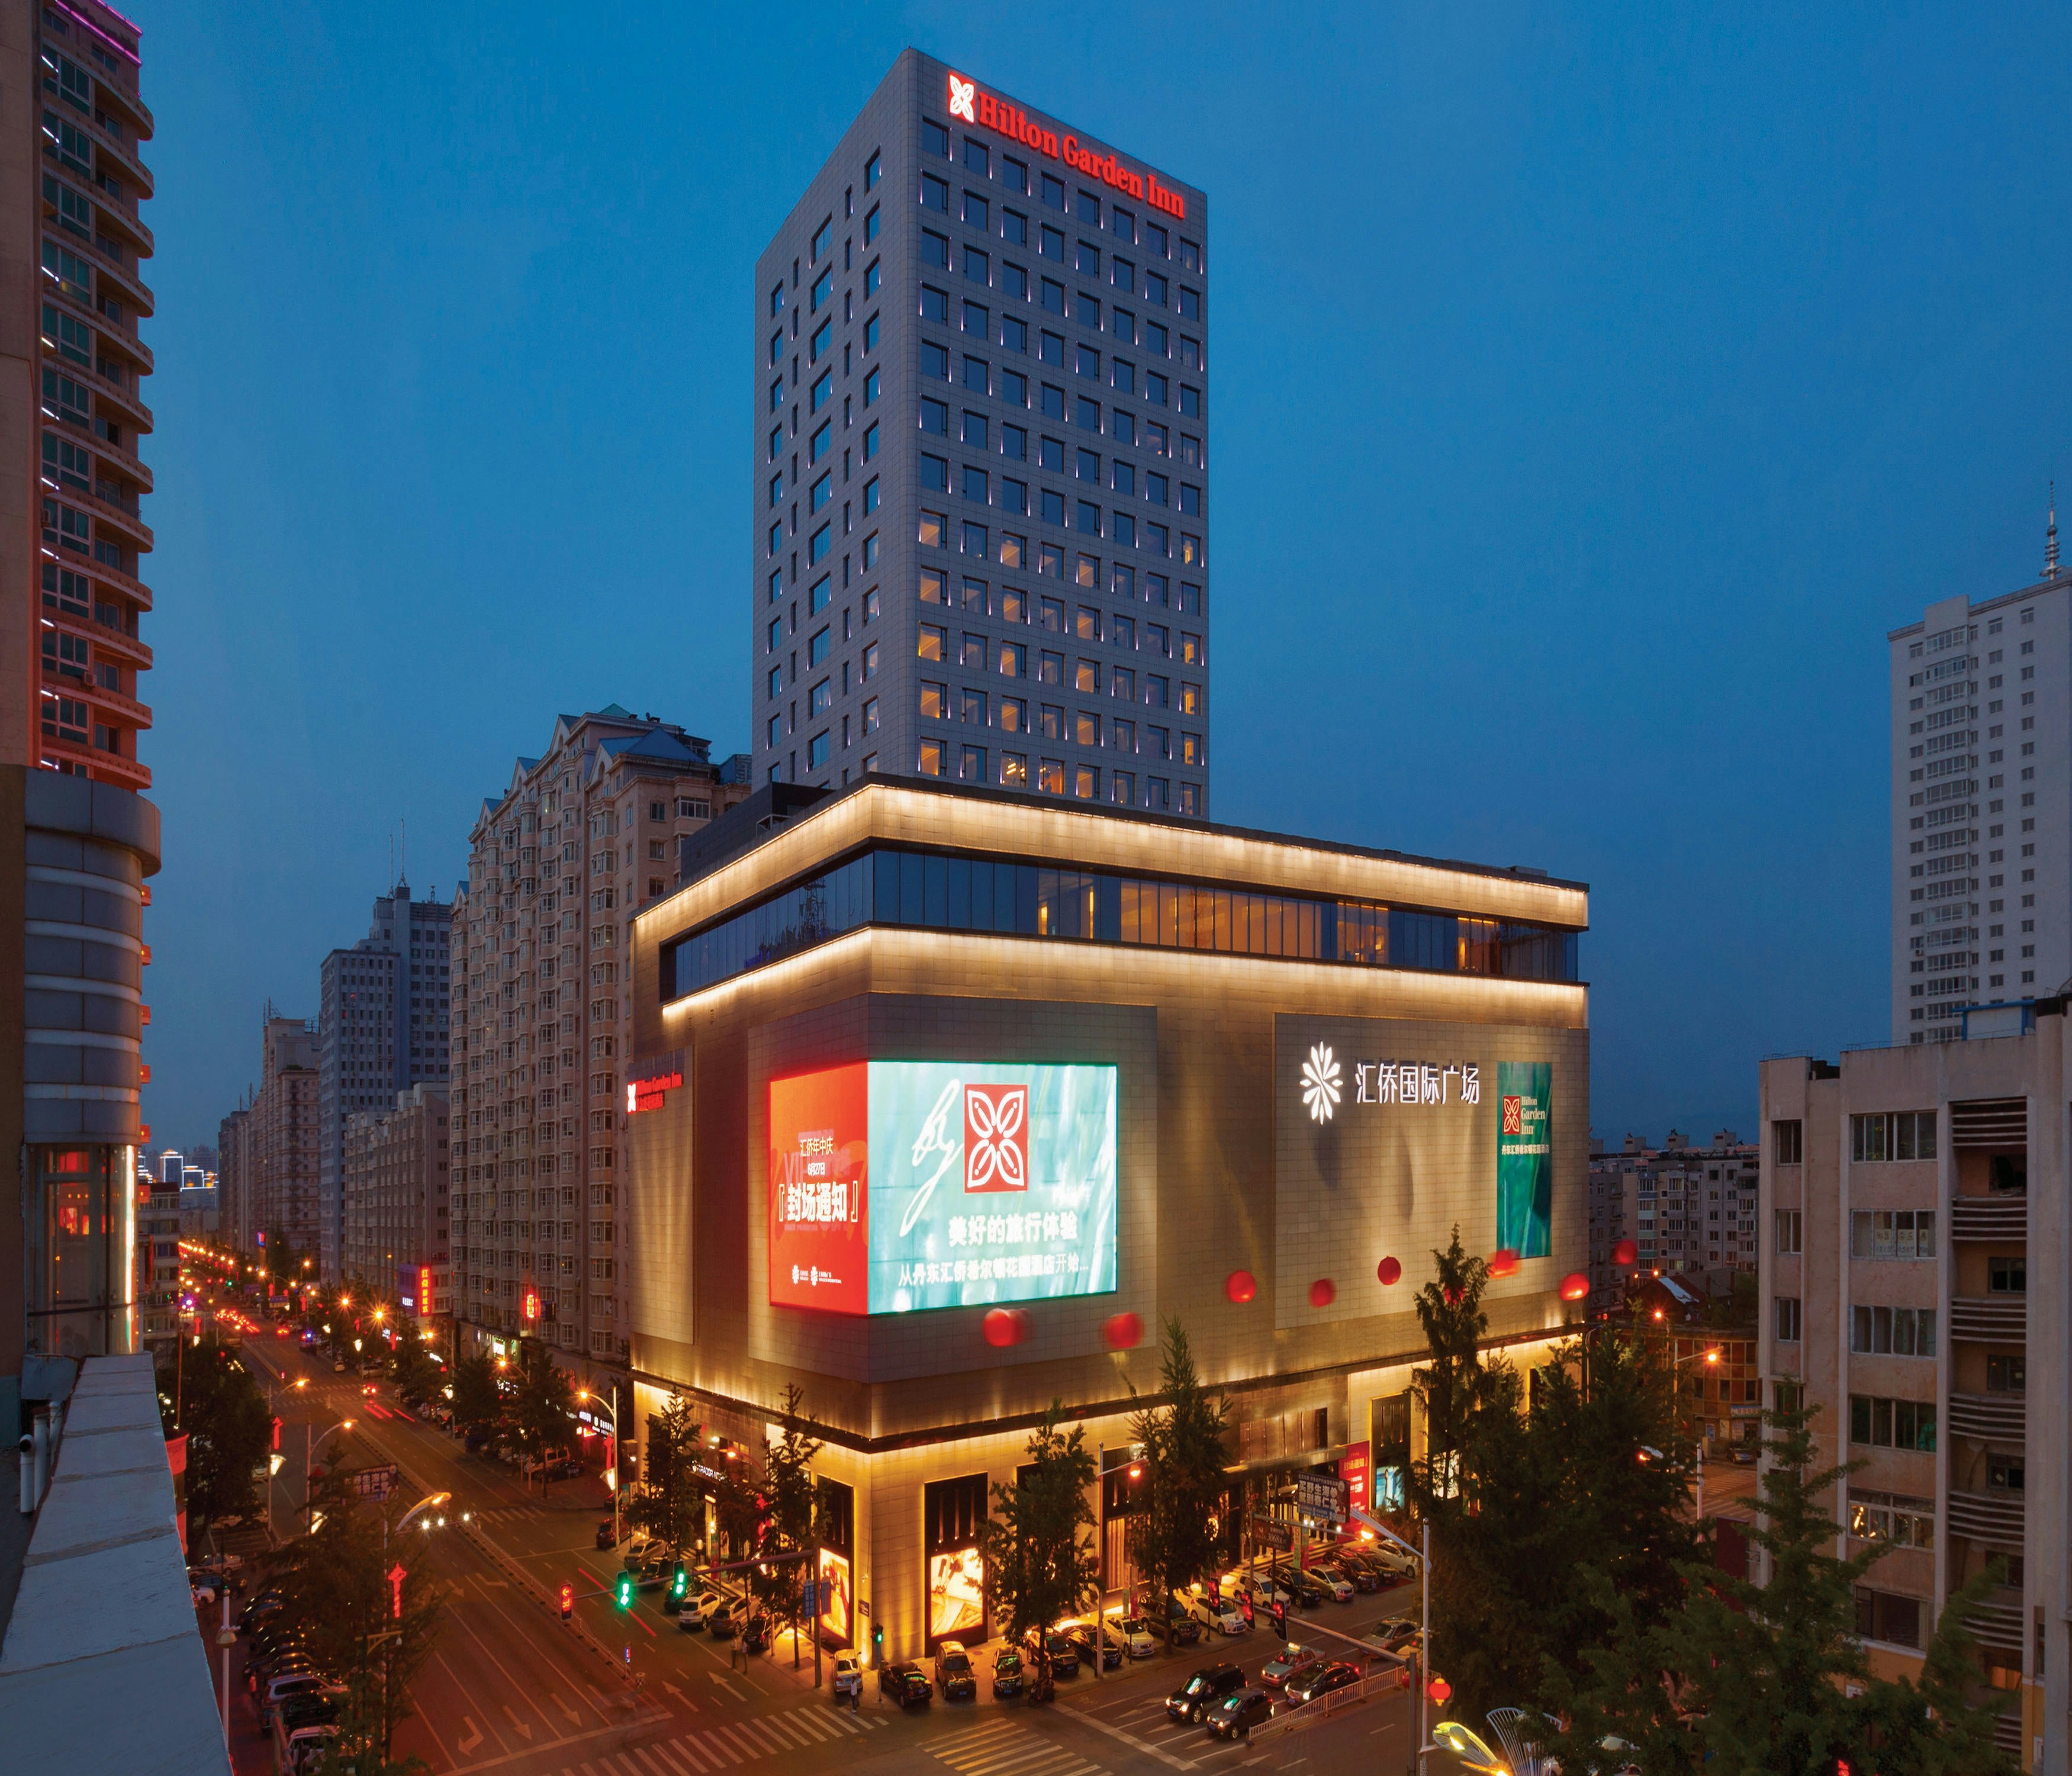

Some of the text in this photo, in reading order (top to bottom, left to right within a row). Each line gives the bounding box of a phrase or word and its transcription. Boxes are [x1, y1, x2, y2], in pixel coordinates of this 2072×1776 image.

[979, 91, 1185, 220] Hilton Garden Inn
[1355, 1063, 1479, 1105] 汇侨国际广场
[1521, 1096, 1537, 1106] Hilton
[1521, 1108, 1545, 1120] Garden
[1521, 1123, 1534, 1135] Inn
[800, 1136, 834, 1157] 汇侨年中庆
[948, 1211, 1078, 1247] 美好的旅行体验
